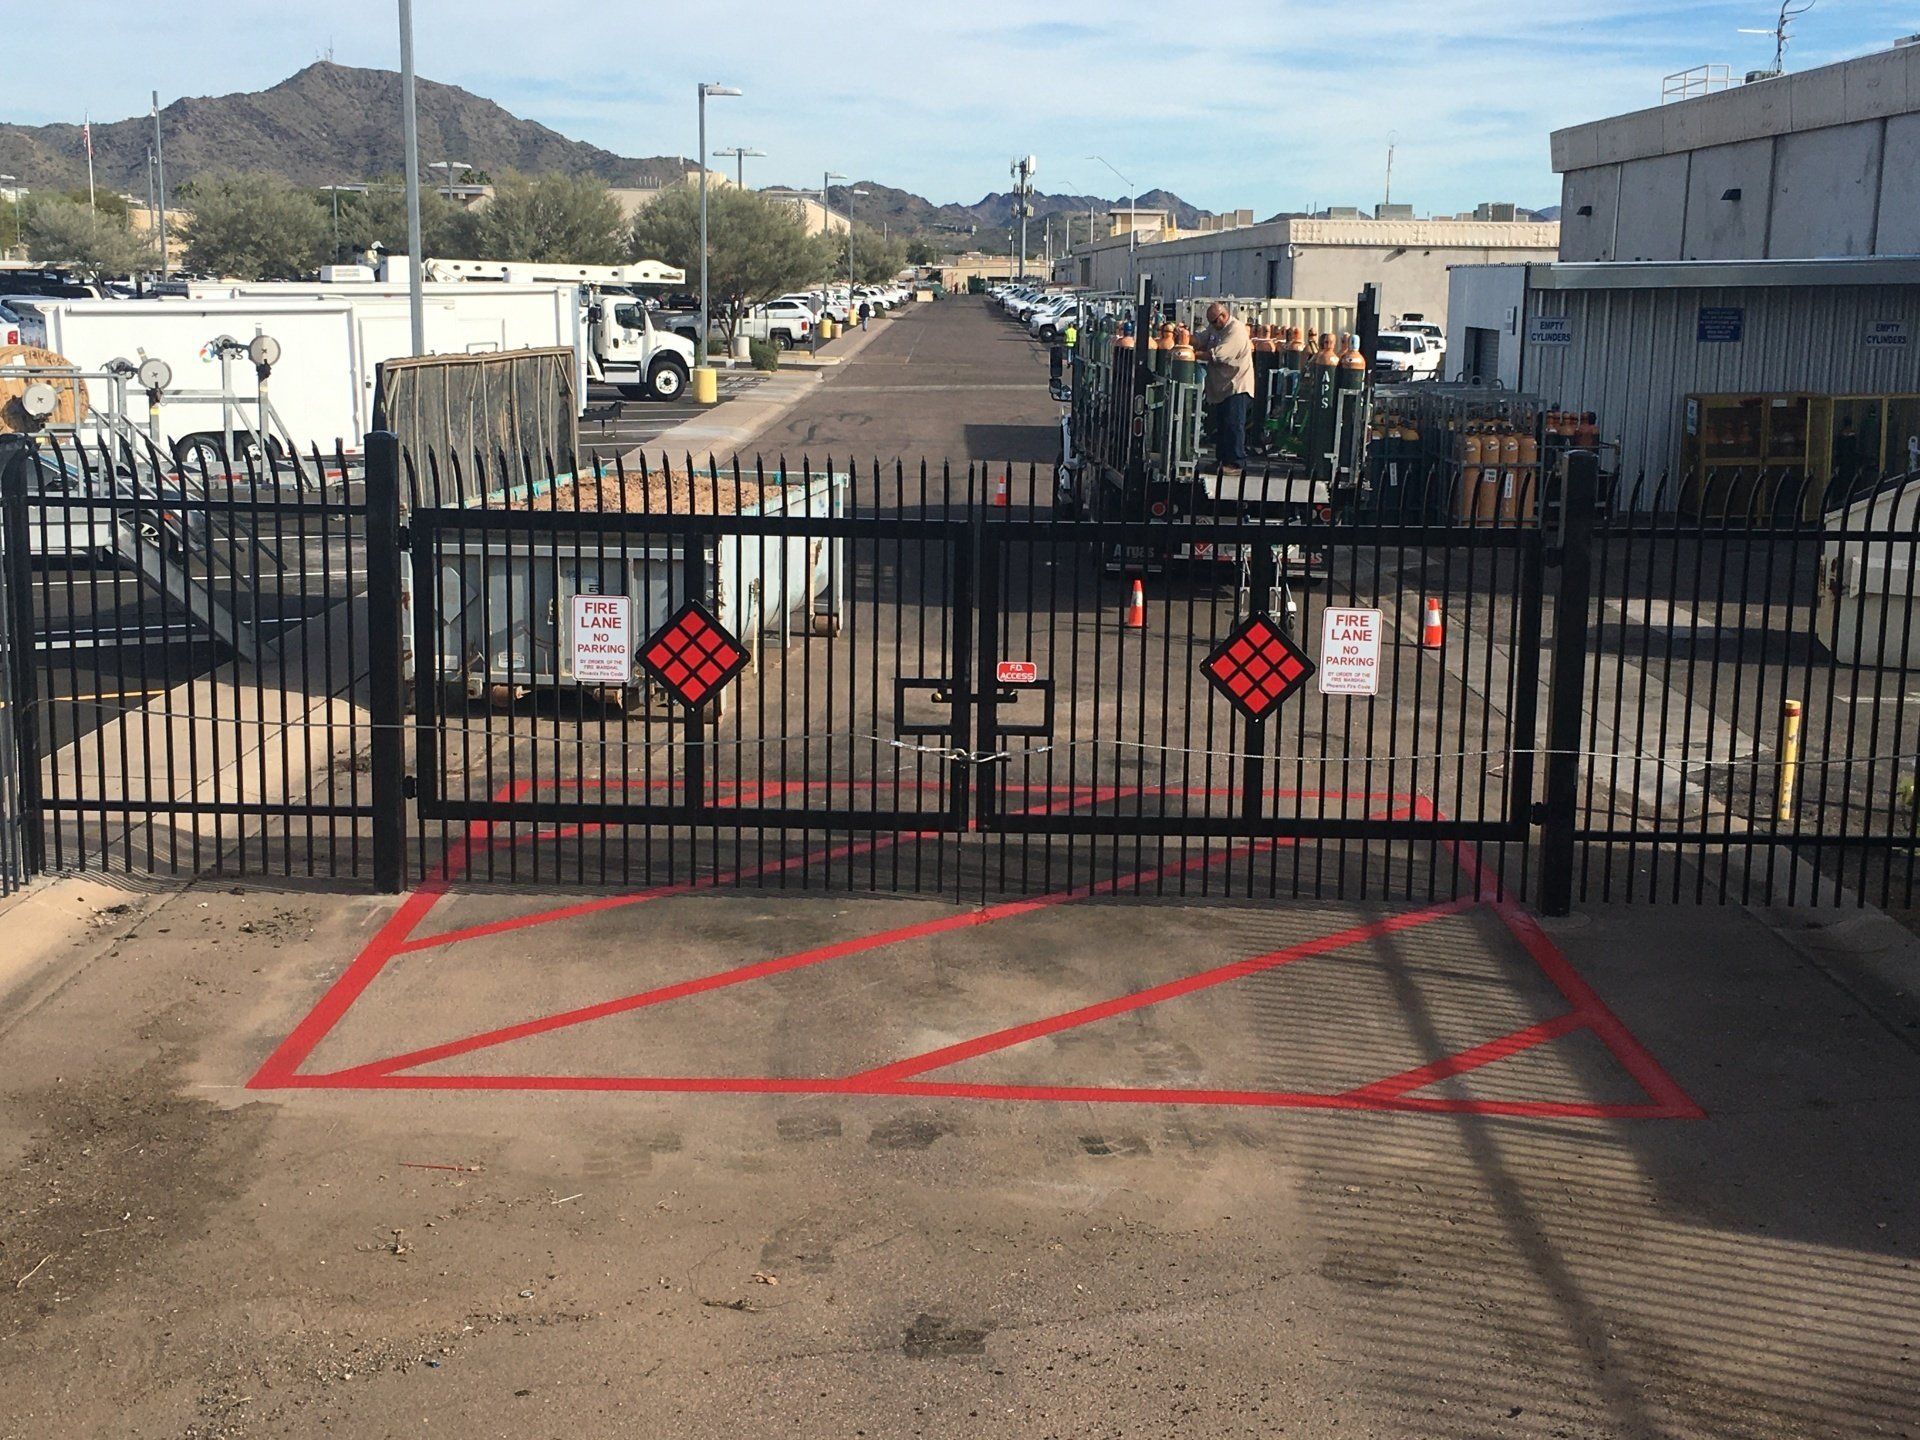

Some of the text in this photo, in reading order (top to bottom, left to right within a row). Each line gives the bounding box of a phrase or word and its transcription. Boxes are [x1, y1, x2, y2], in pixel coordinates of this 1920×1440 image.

[1540, 321, 1564, 330] EMPTY
[1876, 323, 1900, 332] EMPTY
[1531, 332, 1571, 342] CYLINDERS
[1866, 335, 1907, 344] CYLINDERS
[1113, 543, 1155, 559] Argas
[585, 602, 617, 614] FIRE
[581, 616, 622, 629] LANE
[1336, 615, 1369, 627] FIRE
[593, 633, 609, 642] NO
[1332, 630, 1372, 641] LANE
[578, 645, 625, 653] PARKING
[1342, 646, 1359, 655] NO
[1326, 657, 1374, 666] PARKING
[1000, 672, 1033, 680] ACCESS
